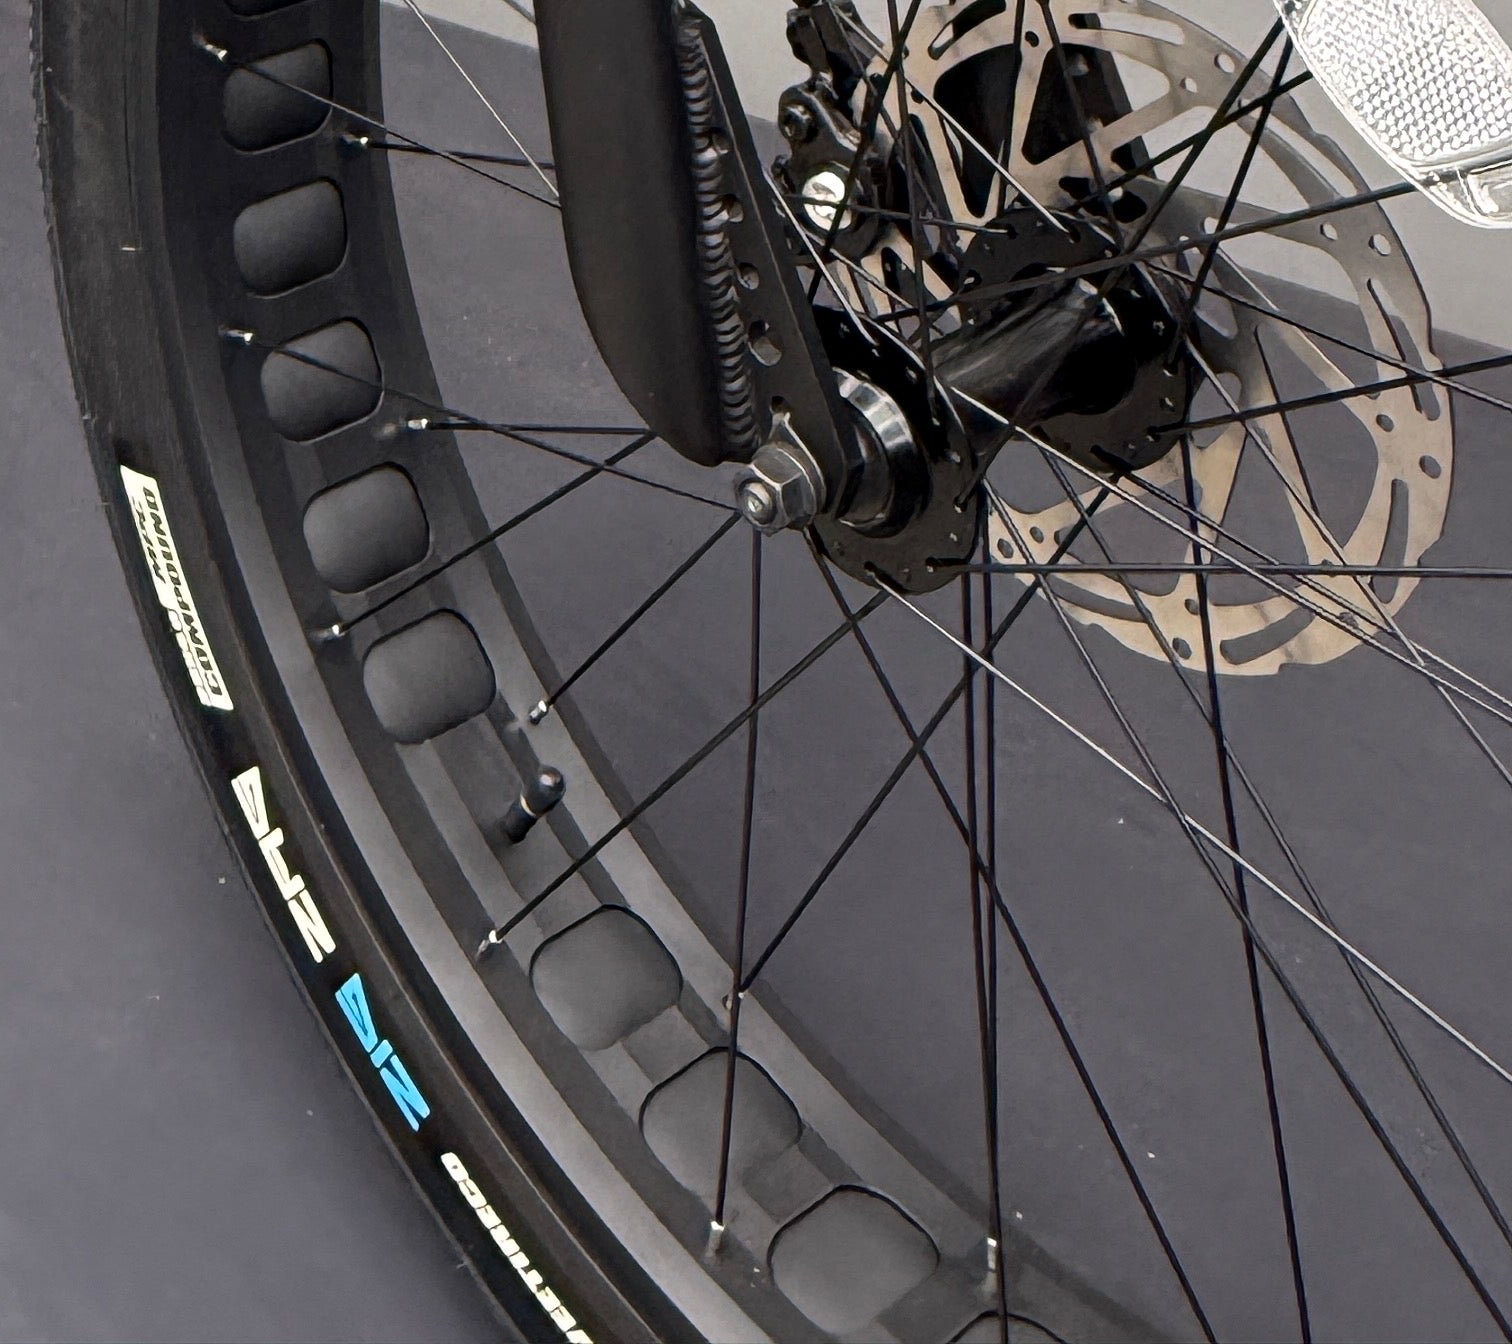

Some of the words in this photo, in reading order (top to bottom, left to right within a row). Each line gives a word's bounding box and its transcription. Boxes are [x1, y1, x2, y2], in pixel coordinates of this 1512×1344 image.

[142, 485, 223, 696] COMPOUND
[230, 765, 337, 964] ZAG
[334, 972, 430, 1132] ZIG
